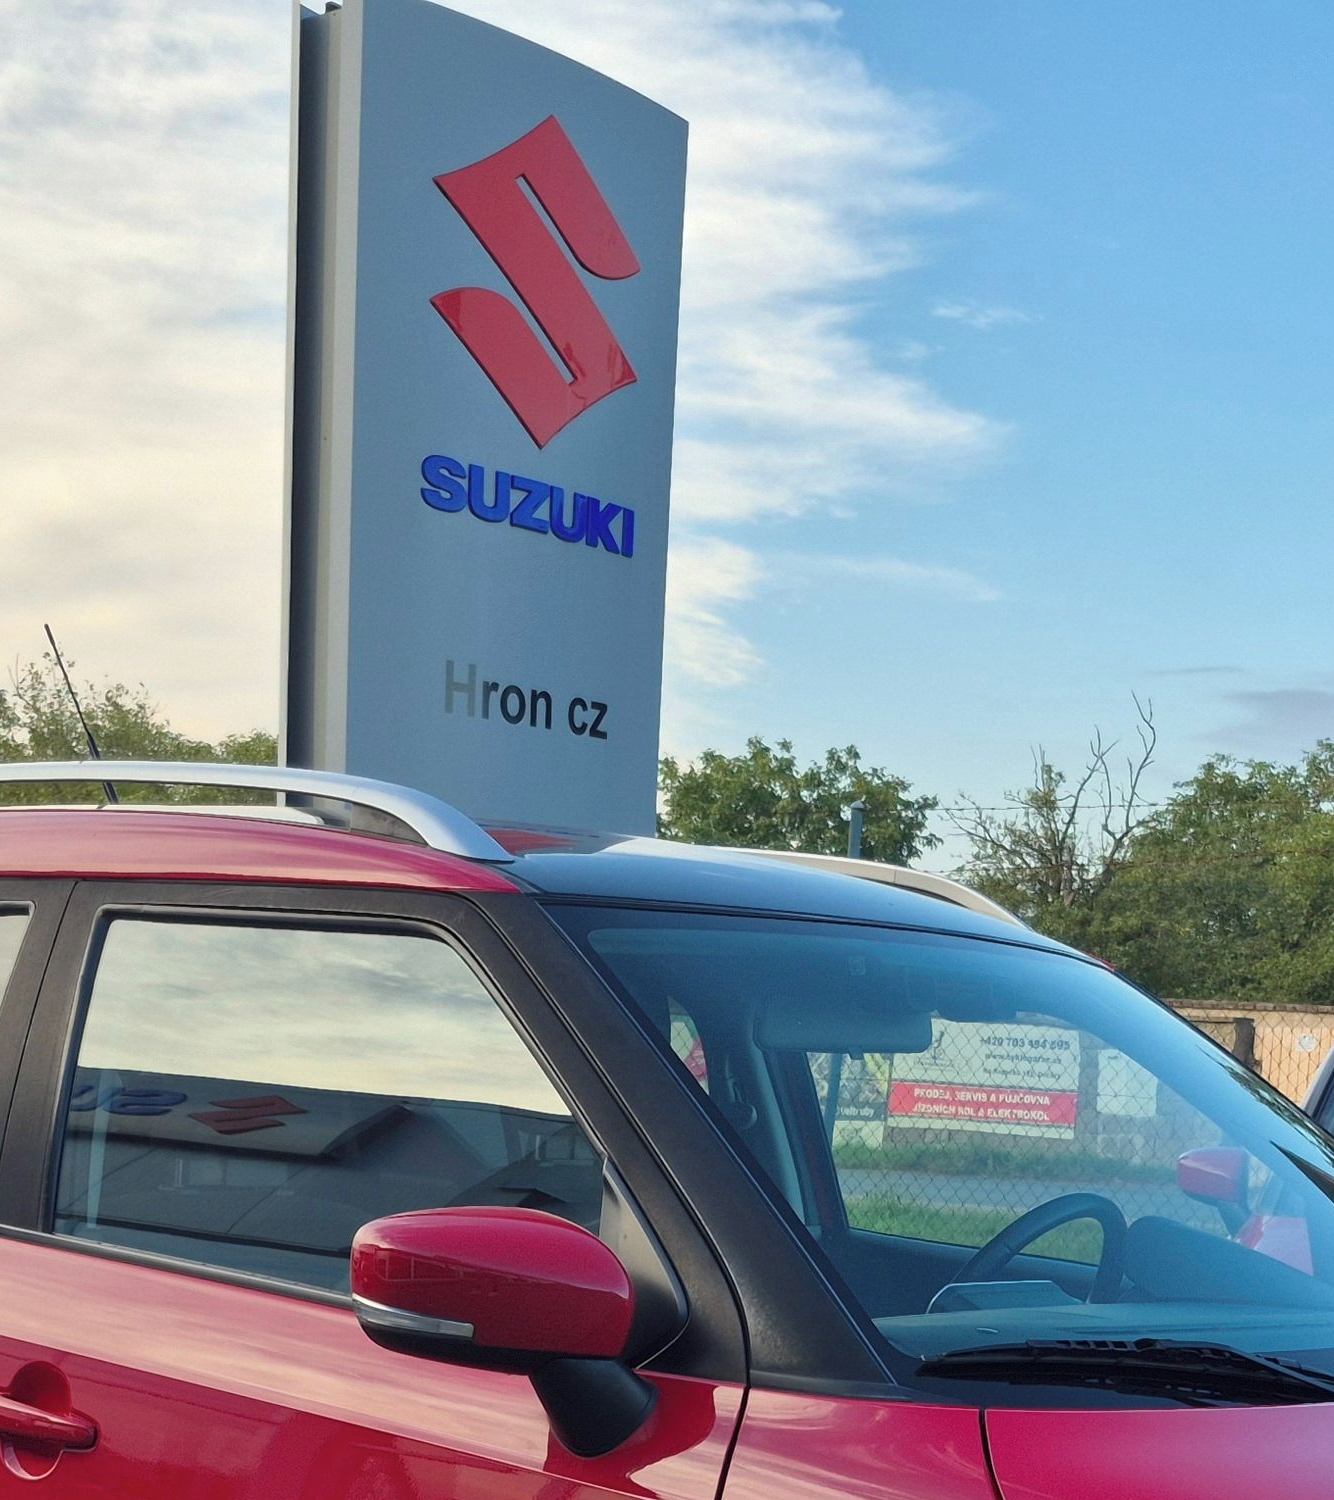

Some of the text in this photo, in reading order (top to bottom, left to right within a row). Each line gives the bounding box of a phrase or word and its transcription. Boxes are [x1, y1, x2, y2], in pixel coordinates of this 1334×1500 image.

[420, 454, 635, 558] SUZUKI
[444, 659, 608, 740] Hron cz
